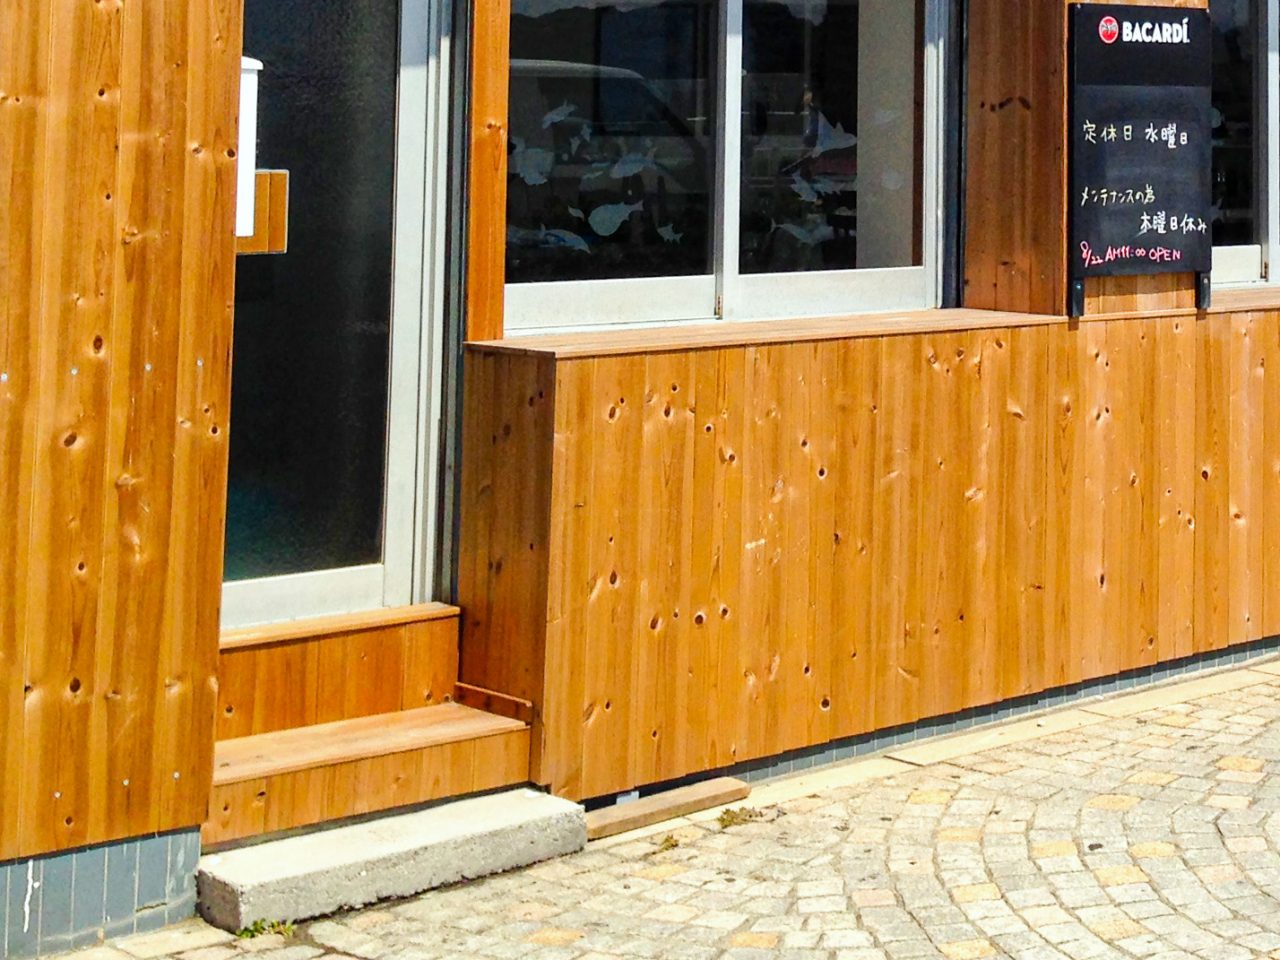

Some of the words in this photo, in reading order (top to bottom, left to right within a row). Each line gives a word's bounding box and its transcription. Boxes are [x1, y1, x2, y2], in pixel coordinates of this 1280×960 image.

[1122, 17, 1190, 43] BACARDÍ
[1083, 119, 1132, 144] 定休日
[1144, 122, 1188, 149] 水曜日
[1148, 246, 1181, 262] OPEN
